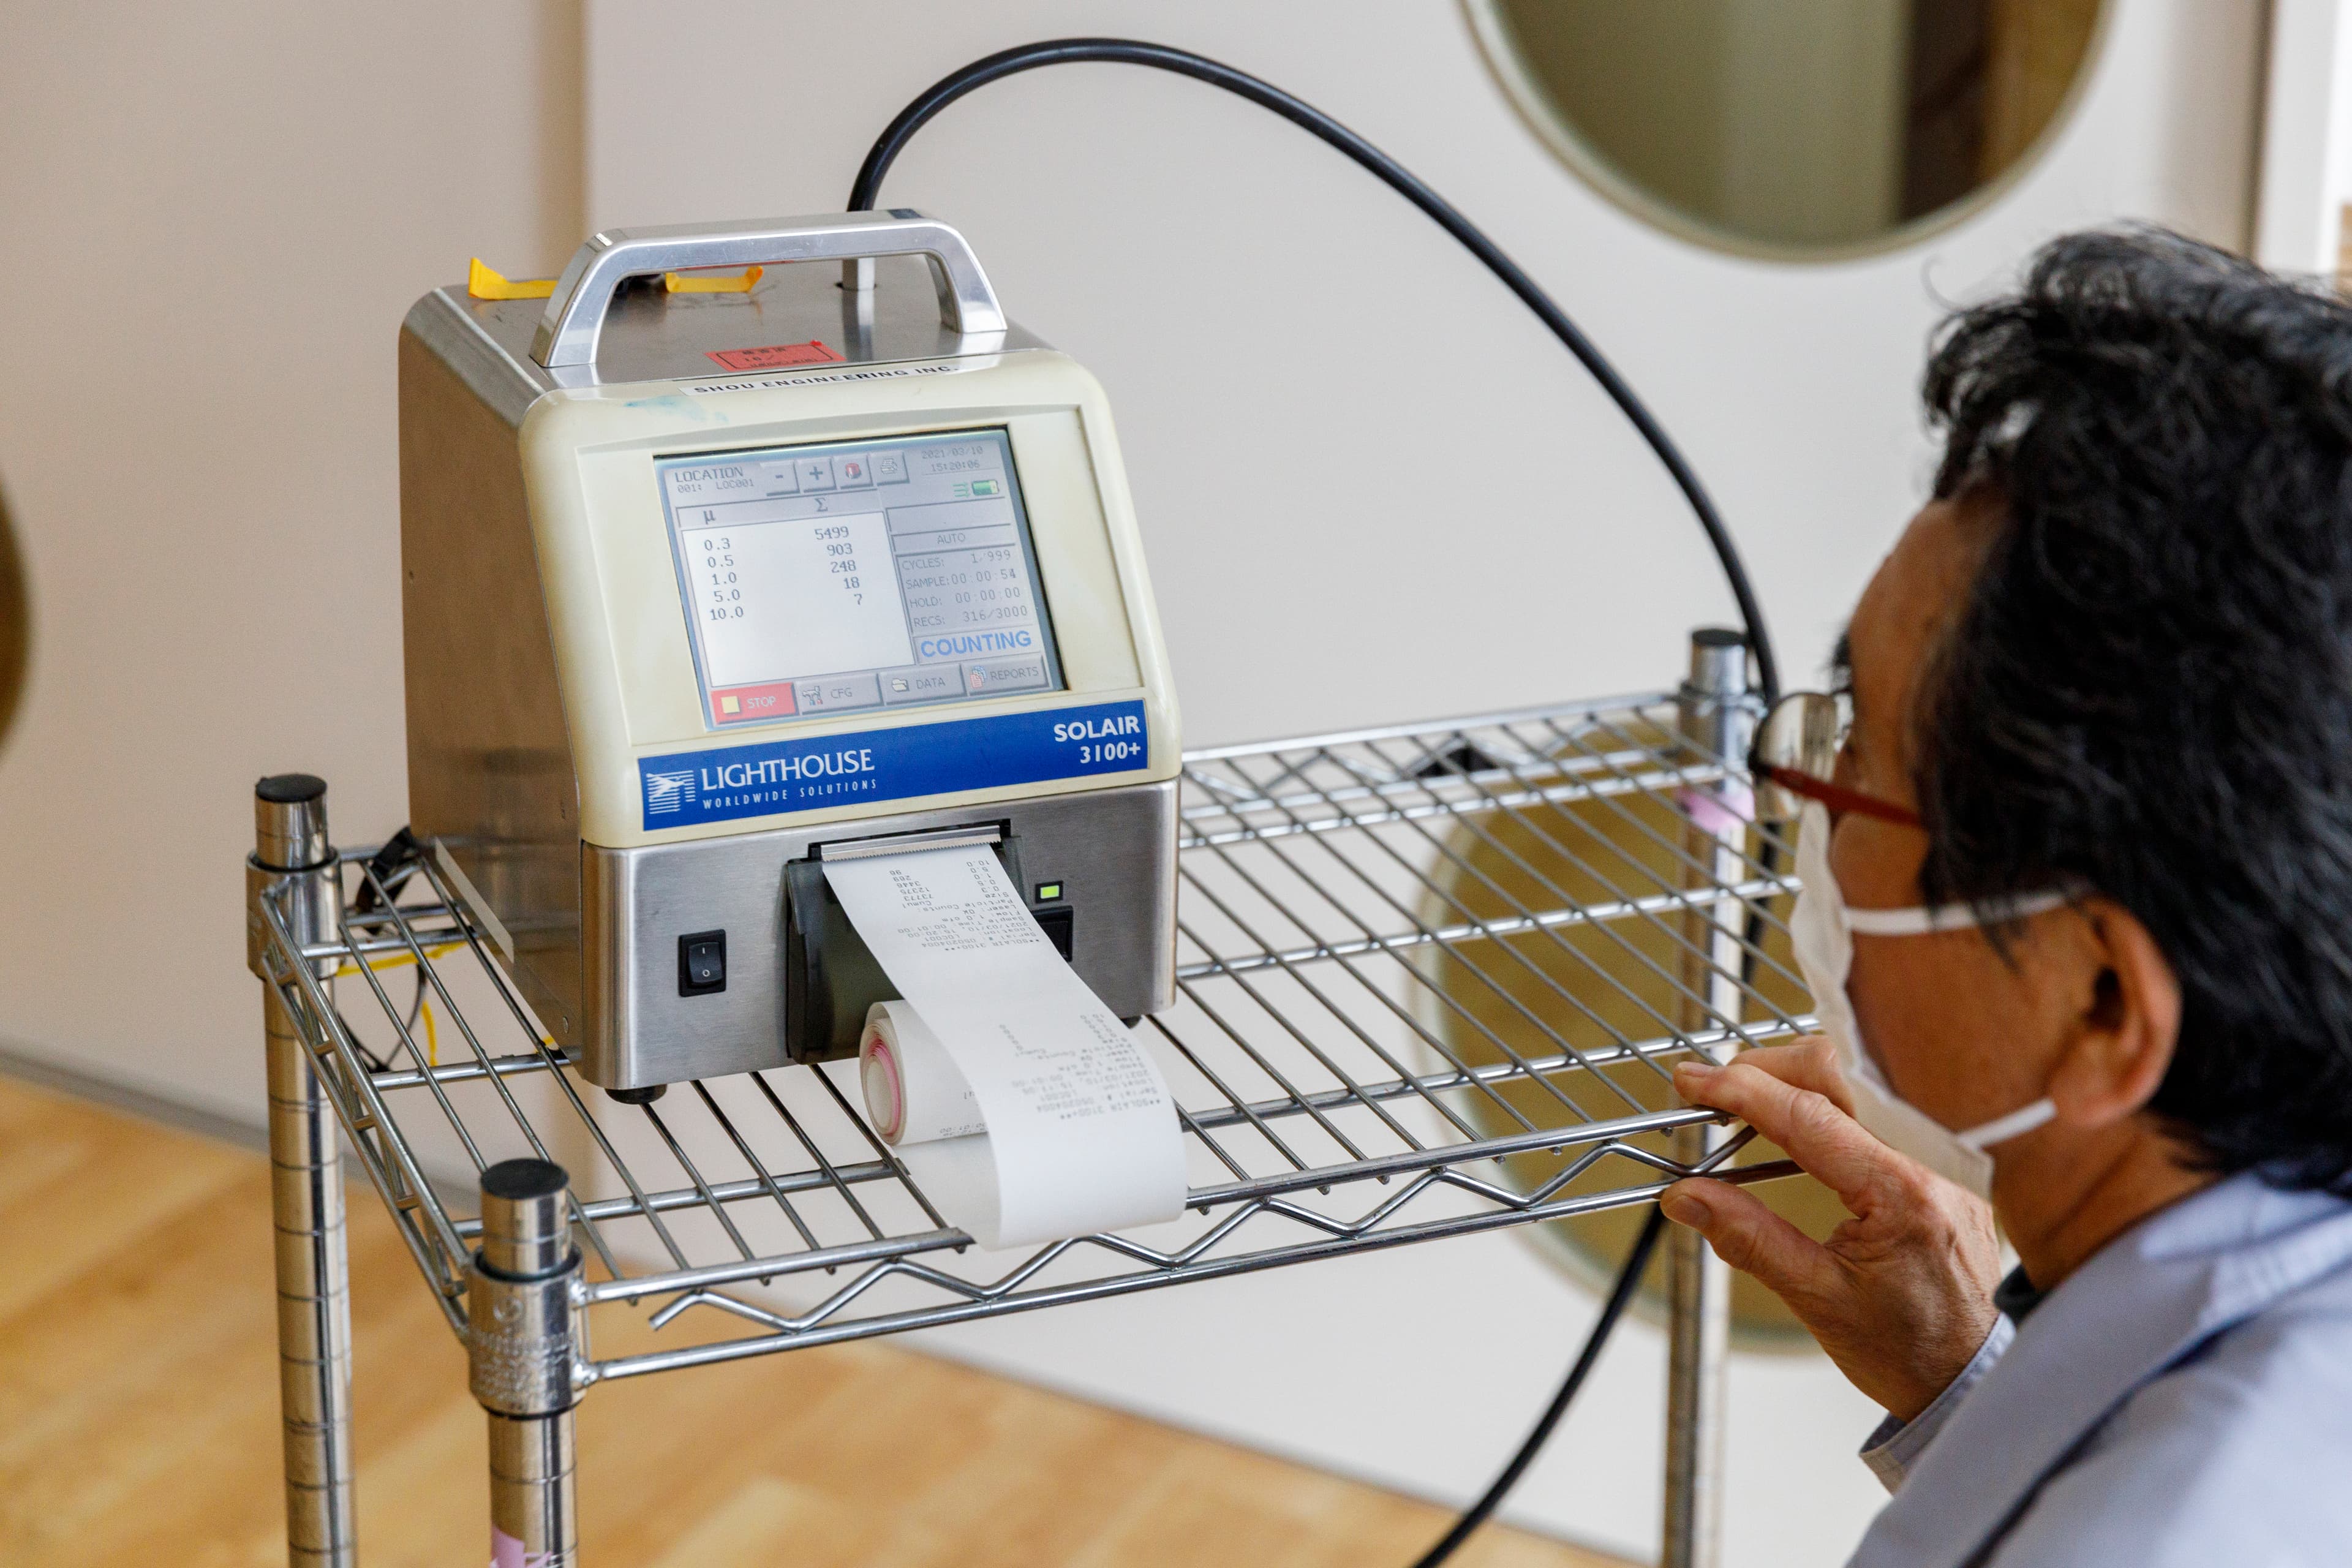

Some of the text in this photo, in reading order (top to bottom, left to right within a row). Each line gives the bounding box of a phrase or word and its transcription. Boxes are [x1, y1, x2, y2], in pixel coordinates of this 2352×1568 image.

[694, 365, 959, 393] SHOU ENGINEERING INC.
[921, 445, 984, 459] 2021/03/10
[674, 466, 744, 483] LOCATION
[715, 478, 755, 490] LOC001
[704, 526, 850, 551] 0.3 5499
[937, 533, 966, 545] AUTO
[707, 543, 853, 568] 0.5 903
[902, 557, 944, 570] CYCLES:
[712, 559, 857, 586] 1.0 248
[906, 576, 949, 589] SAMPLE:
[714, 576, 861, 603] 5.0 18
[710, 593, 863, 620] 10.0 7
[910, 596, 943, 608] HOLD:
[913, 605, 1028, 628] RECS: 316/3000
[920, 630, 1032, 658] COUNTING
[916, 676, 946, 689] DATA
[989, 666, 1039, 680] REPORTS
[747, 695, 777, 710] STOP
[830, 687, 852, 700] CFG
[1054, 715, 1142, 742] SOLAIR
[1080, 742, 1142, 764] 3100+
[701, 748, 876, 791] LIGHTHOUSE
[703, 778, 877, 810] WORLDWIDE SOLUTIONS
